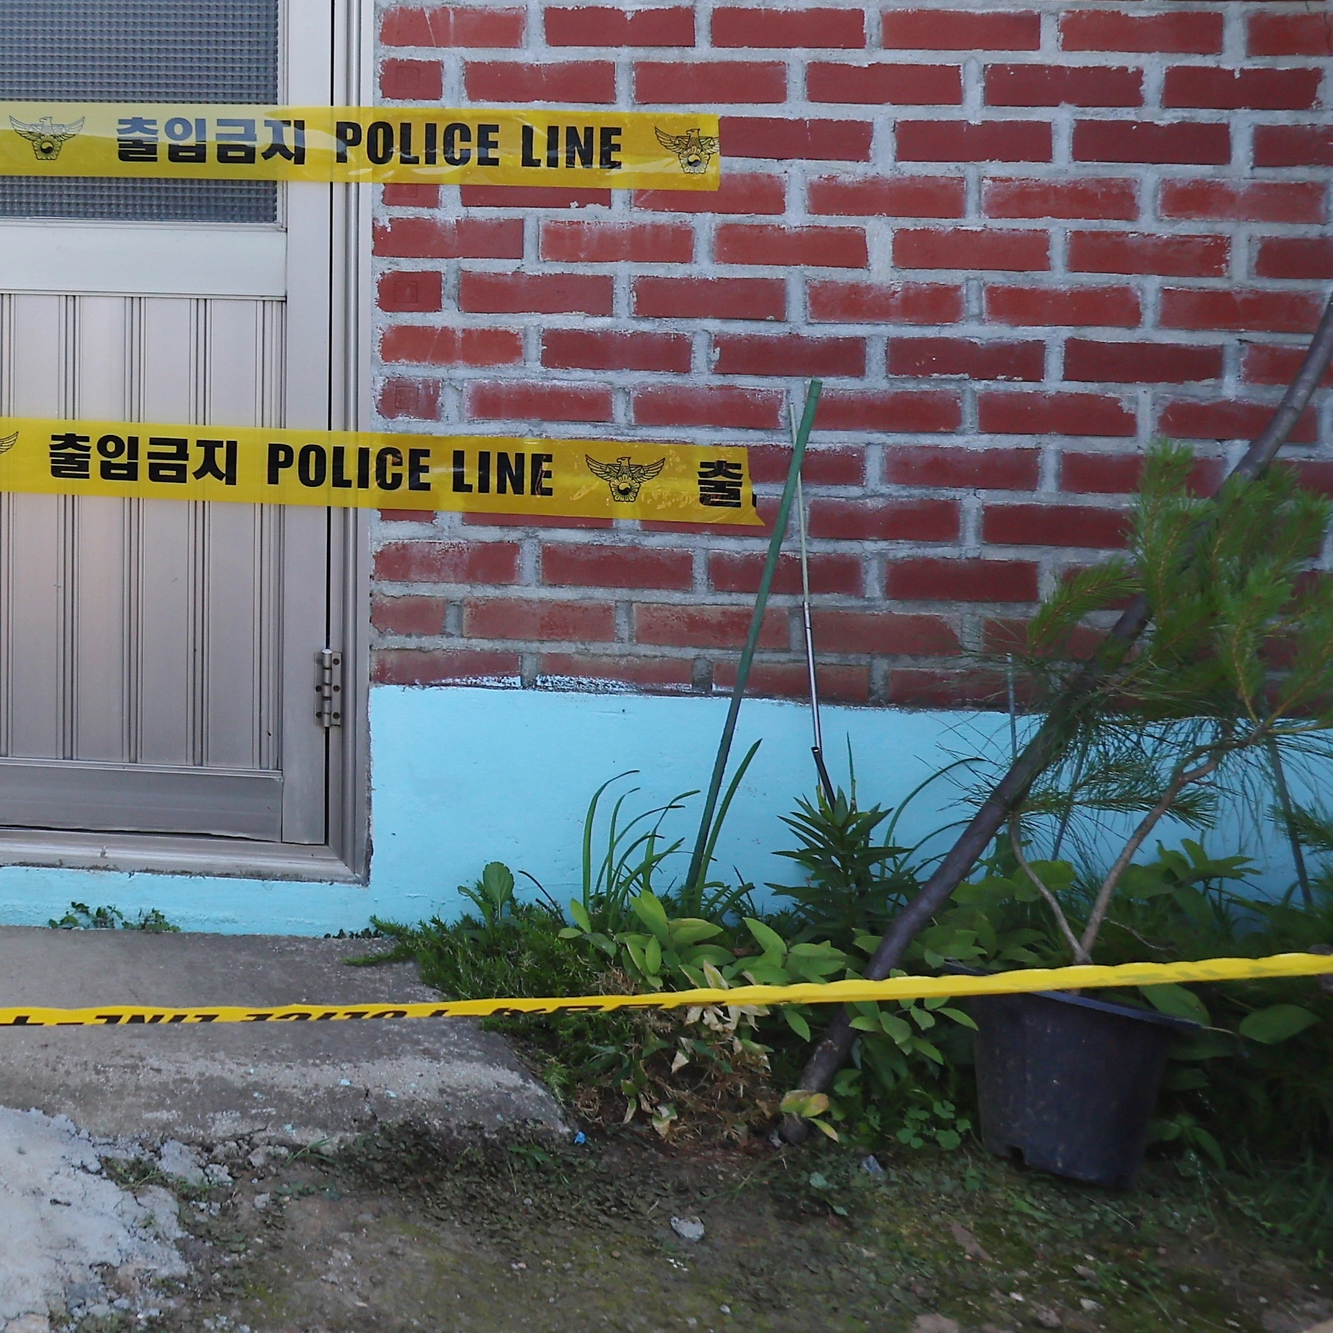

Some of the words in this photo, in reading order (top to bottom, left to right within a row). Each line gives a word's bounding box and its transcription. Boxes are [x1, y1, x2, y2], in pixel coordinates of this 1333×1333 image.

[116, 115, 305, 165] 출입금지
[335, 119, 500, 167] POLICE
[521, 124, 622, 170] LINE
[48, 433, 238, 486] 출입금지
[267, 442, 431, 493] POLICE
[454, 449, 554, 497] LINE
[697, 460, 757, 508] 출
